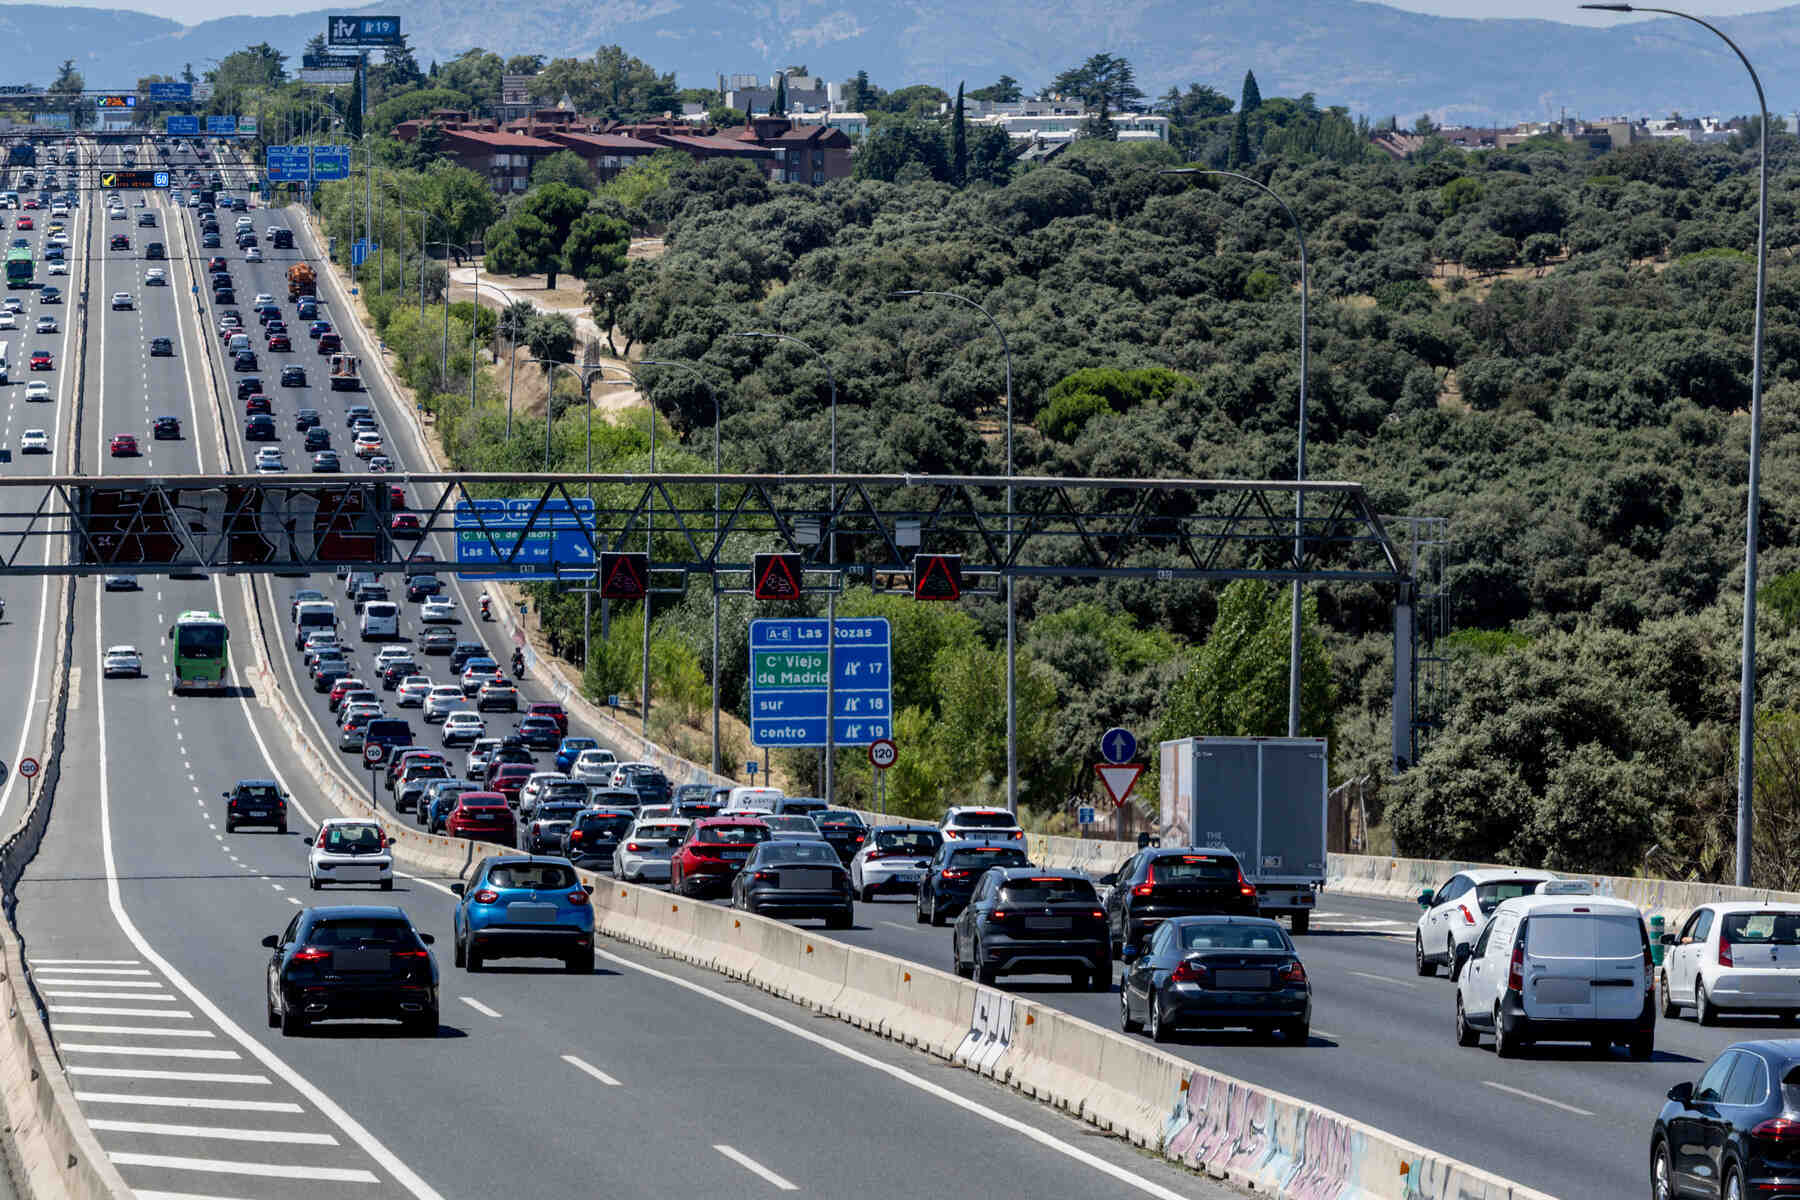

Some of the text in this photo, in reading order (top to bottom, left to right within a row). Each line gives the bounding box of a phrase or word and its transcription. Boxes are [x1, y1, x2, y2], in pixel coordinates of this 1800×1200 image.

[333, 18, 356, 37] itv
[156, 174, 167, 184] 60
[462, 546, 483, 557] Las
[797, 627, 823, 639] Las
[785, 655, 822, 669] Viejo
[869, 662, 883, 674] 17
[758, 671, 829, 684] de Madrid
[760, 700, 784, 711] sur
[869, 697, 884, 710] 18
[760, 726, 806, 739] centro
[869, 724, 884, 737] 19
[874, 748, 893, 759] 120
